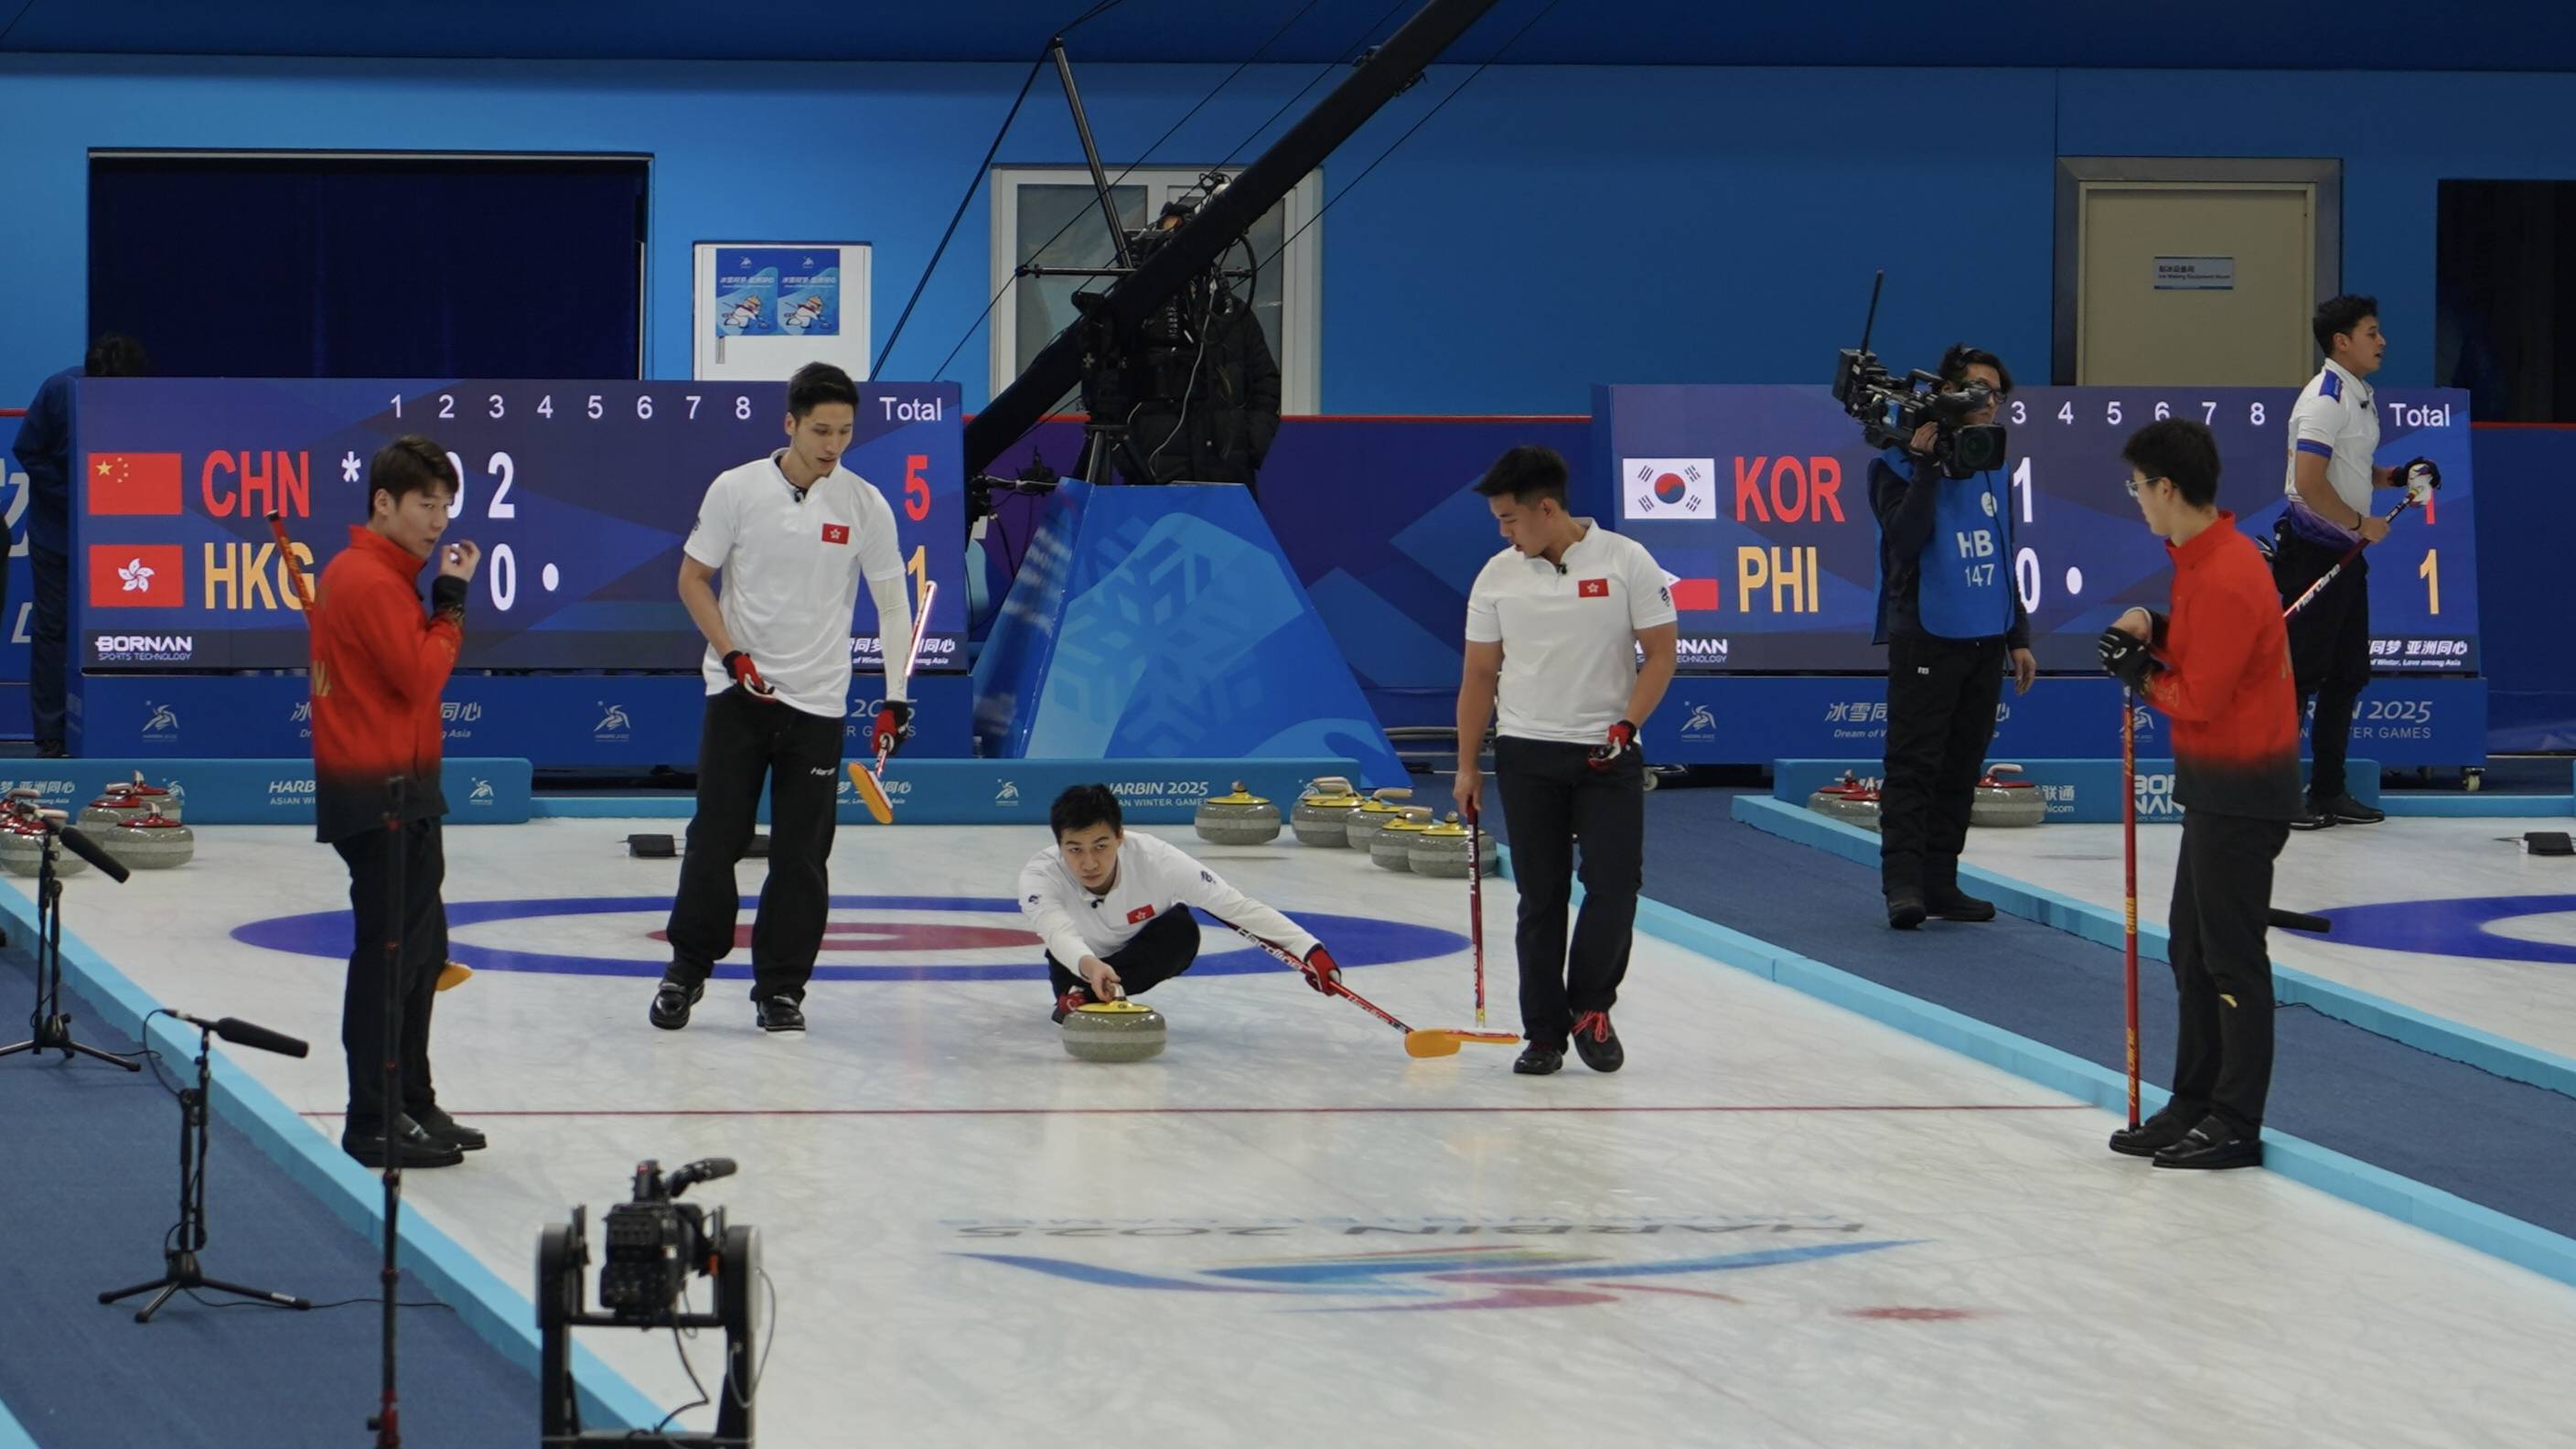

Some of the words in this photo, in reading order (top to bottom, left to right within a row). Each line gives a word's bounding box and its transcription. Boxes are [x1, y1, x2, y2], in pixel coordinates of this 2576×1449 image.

[391, 394, 402, 418] 1
[439, 395, 455, 419] 2
[488, 395, 505, 419] 3
[536, 395, 553, 419] 4
[587, 395, 604, 419] 5
[637, 395, 653, 419] 6
[685, 395, 702, 419] 7
[735, 395, 751, 419] 8
[879, 396, 942, 422] Total
[2011, 402, 2027, 424] 3
[2057, 402, 2074, 424] 4
[2107, 402, 2122, 424] 5
[2154, 402, 2171, 420] 6
[2201, 402, 2217, 424] 7
[2249, 402, 2266, 425] 8
[2389, 403, 2451, 427] Total
[201, 449, 311, 519] CHN
[488, 452, 515, 519] 2
[904, 455, 931, 521] 5
[1734, 456, 1846, 523] KOR
[2013, 456, 2034, 523] 1
[1956, 530, 1994, 558] HB
[204, 542, 317, 610] HKG
[489, 543, 516, 611] 0
[907, 545, 928, 611] 1
[1737, 546, 1819, 614] PHI
[2015, 547, 2041, 614] 0
[2419, 549, 2440, 615] 1
[1965, 564, 1995, 587] 147
[95, 636, 192, 652] BORNAN
[918, 638, 956, 653] 同心
[2369, 639, 2401, 655] 同梦
[1676, 654, 1727, 663] ECHNOLOGY
[1824, 703, 1888, 722] 冰雪同
[2367, 701, 2433, 723] 2025
[2378, 727, 2431, 739] GAMES
[269, 779, 317, 794] HARB
[1167, 782, 1209, 797] 2025
[1134, 798, 1173, 806] WINTER
